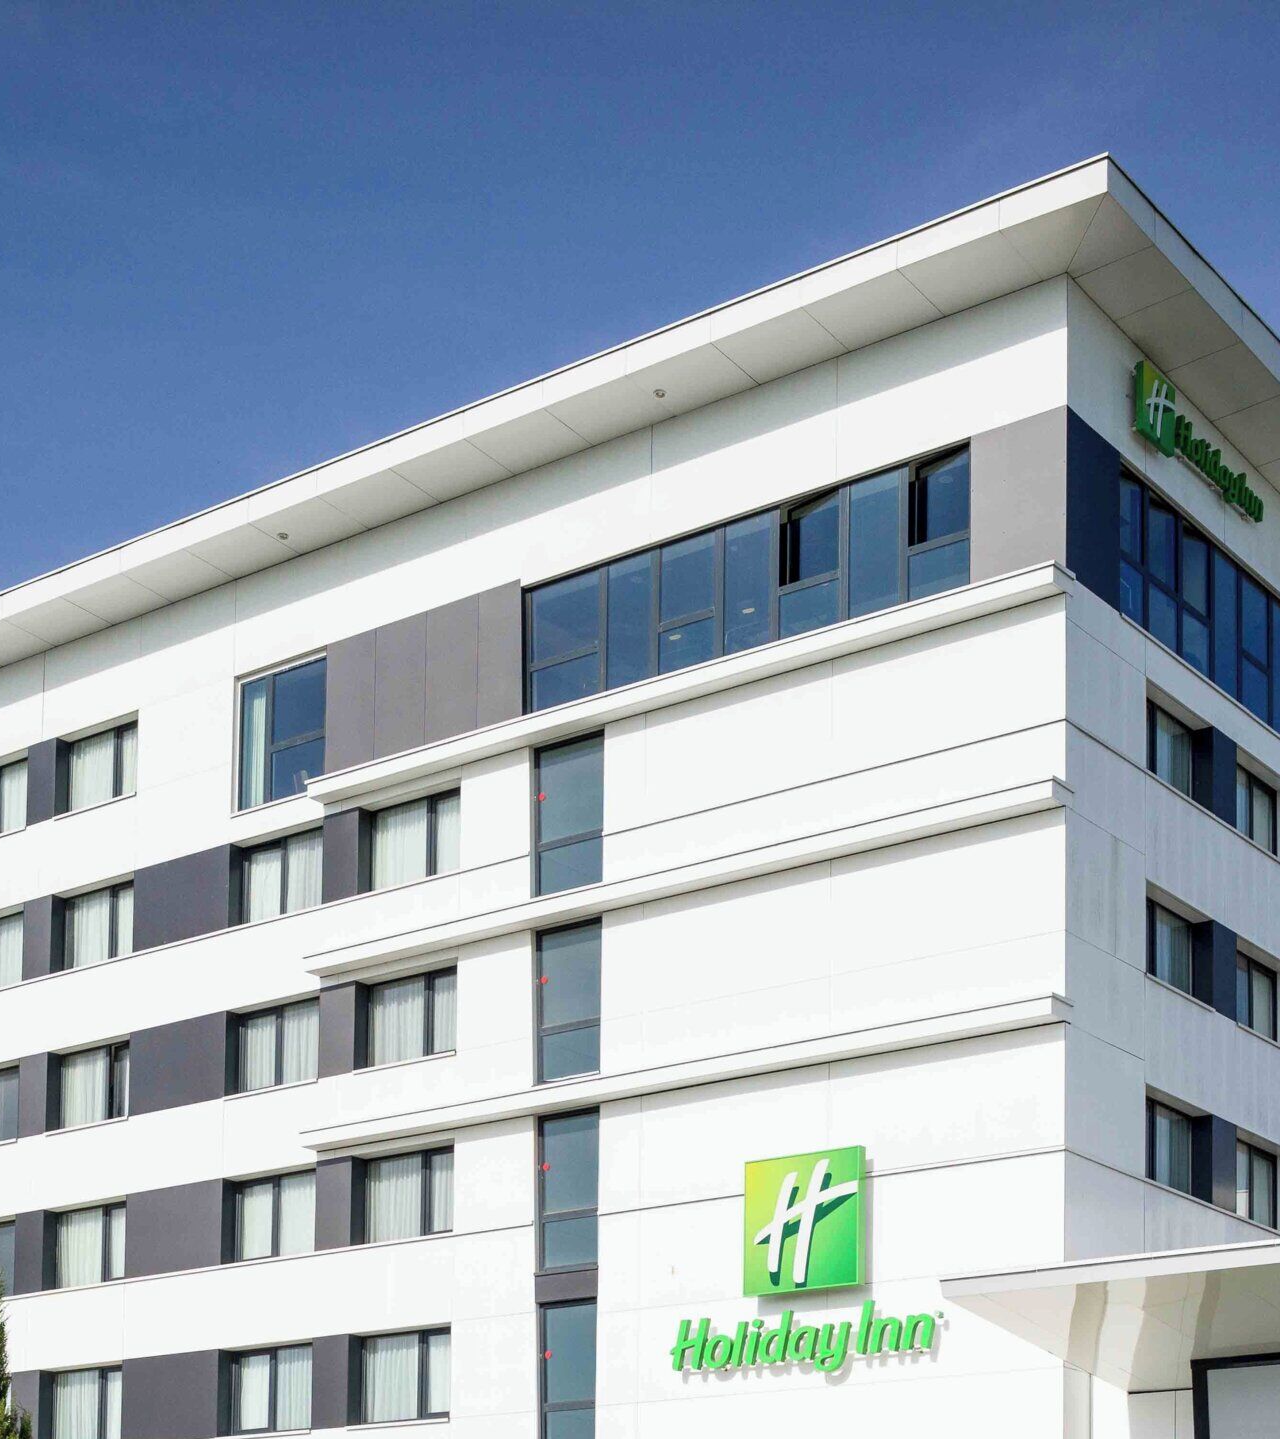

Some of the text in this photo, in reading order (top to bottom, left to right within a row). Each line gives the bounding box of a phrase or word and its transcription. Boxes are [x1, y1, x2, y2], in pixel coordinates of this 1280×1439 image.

[1175, 415, 1264, 522] Holiday Inn
[671, 1299, 936, 1372] Holiday Inn
